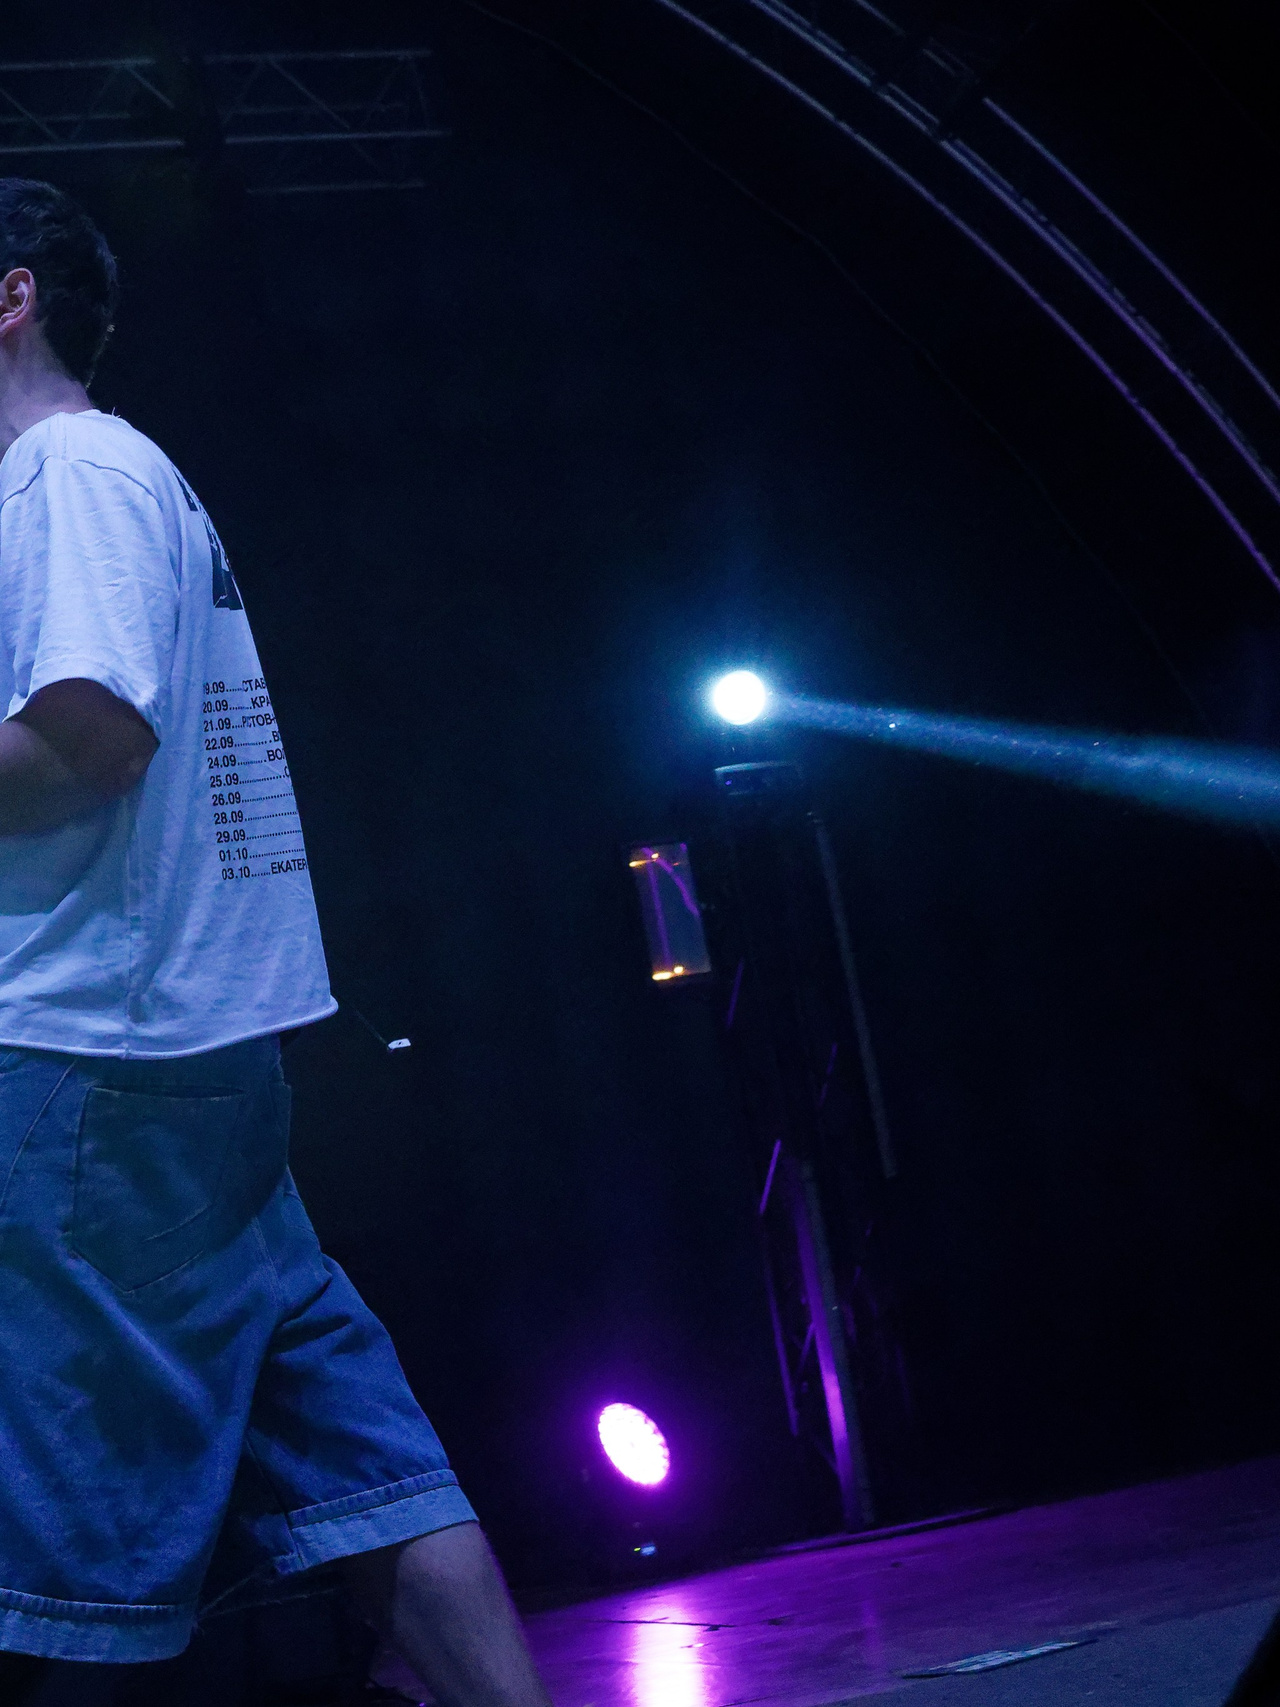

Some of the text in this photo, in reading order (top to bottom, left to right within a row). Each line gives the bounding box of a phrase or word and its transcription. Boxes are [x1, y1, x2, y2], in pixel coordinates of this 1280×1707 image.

[203, 699, 228, 713] 20.09
[204, 717, 231, 732] 21.09
[205, 736, 234, 750] 22.09
[207, 754, 236, 769] 24.09
[209, 773, 239, 788] 25.09
[212, 791, 241, 806] 26.09
[214, 810, 244, 825] 28.09
[216, 829, 246, 843] 29.09
[219, 847, 248, 862] 01.10
[222, 858, 309, 880] 03.10 ЕКАТЕР
